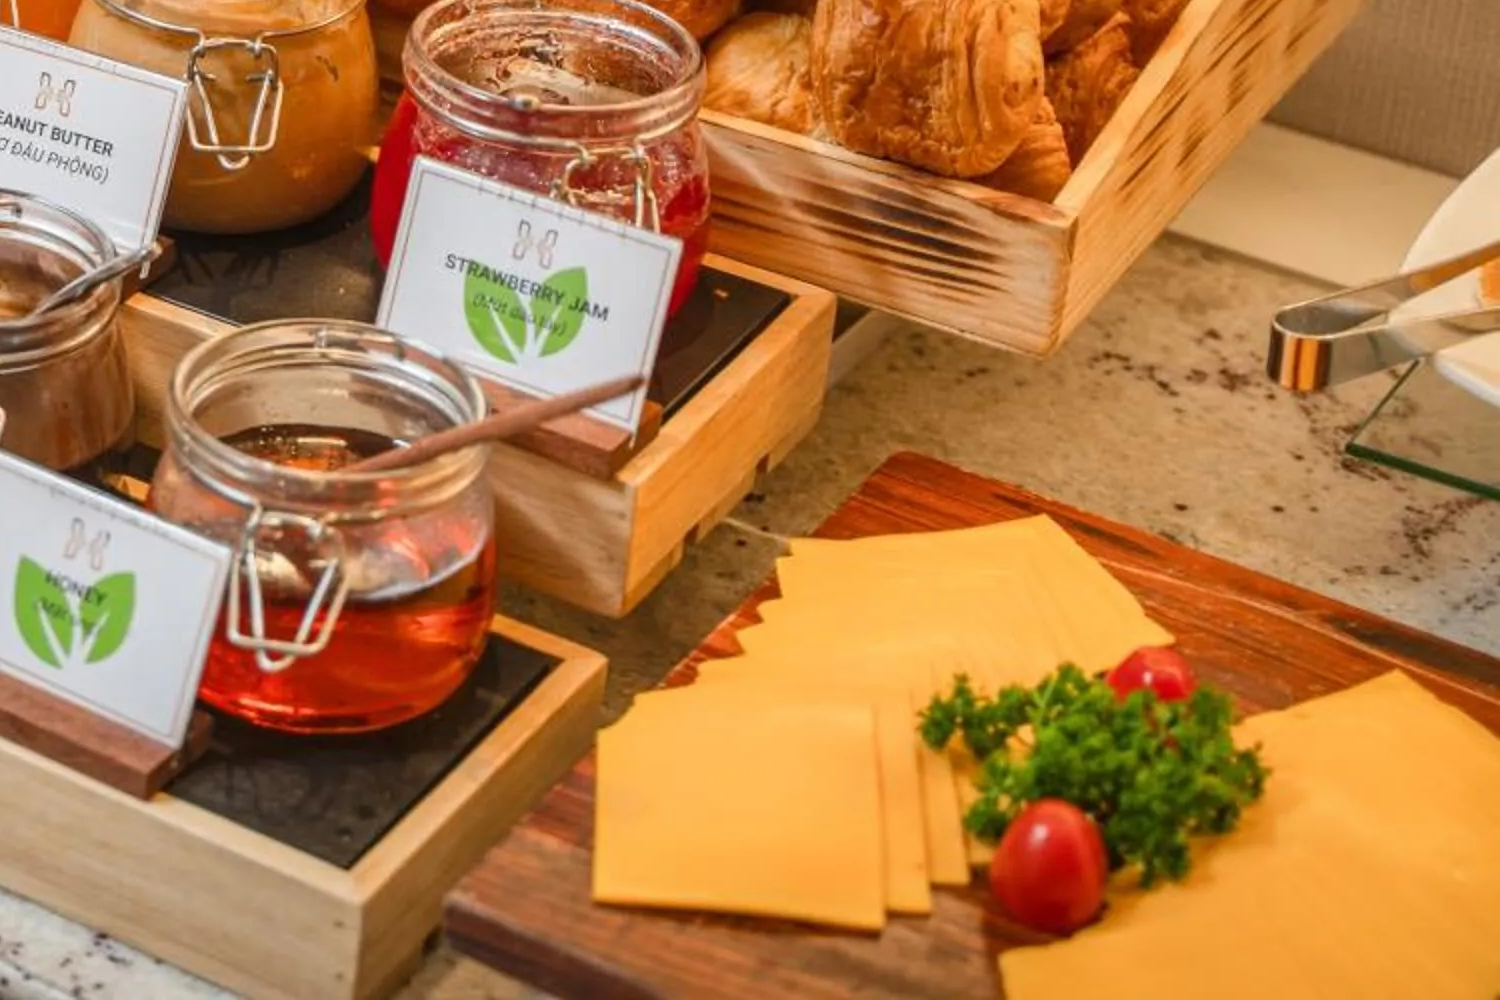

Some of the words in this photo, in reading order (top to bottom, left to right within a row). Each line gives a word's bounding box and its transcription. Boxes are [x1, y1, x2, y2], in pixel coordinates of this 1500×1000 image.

[51, 125, 114, 157] BUTTER
[445, 252, 565, 306] STRAWBERRY
[568, 298, 610, 322] JAM
[44, 570, 108, 607] HONEY
